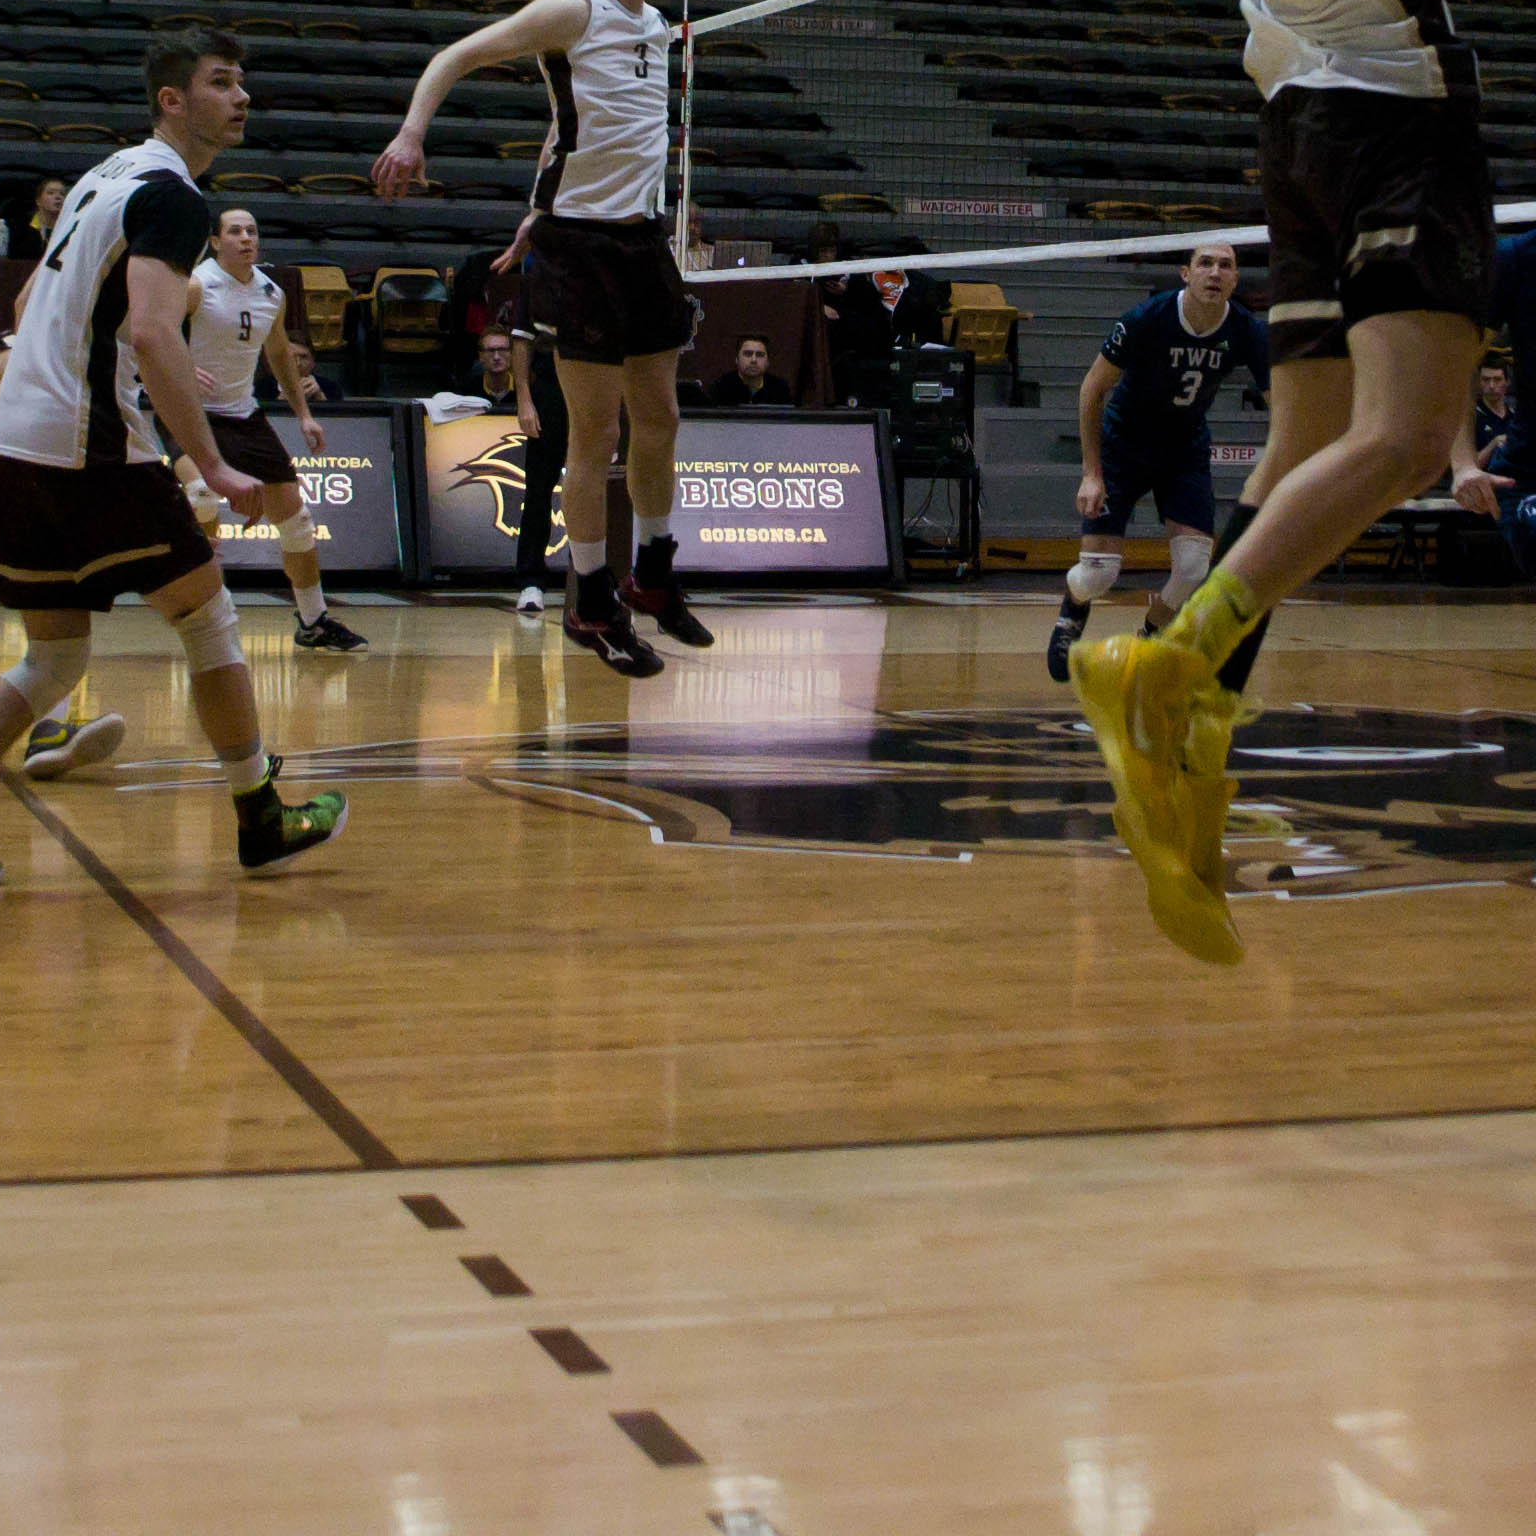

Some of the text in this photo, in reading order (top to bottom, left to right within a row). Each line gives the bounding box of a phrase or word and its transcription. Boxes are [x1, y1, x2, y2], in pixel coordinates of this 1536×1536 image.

[633, 42, 650, 79] 3
[919, 201, 1033, 216] WATCH YOUR STEP
[45, 190, 97, 273] 2
[238, 310, 252, 342] 9
[1168, 346, 1224, 370] TWU
[1171, 369, 1205, 409] 3
[1221, 447, 1256, 460] STEP
[674, 461, 861, 475] IVERSITY OF MANITOBA
[679, 477, 845, 509] BISONS
[698, 527, 828, 544] GOBISONS.CA
